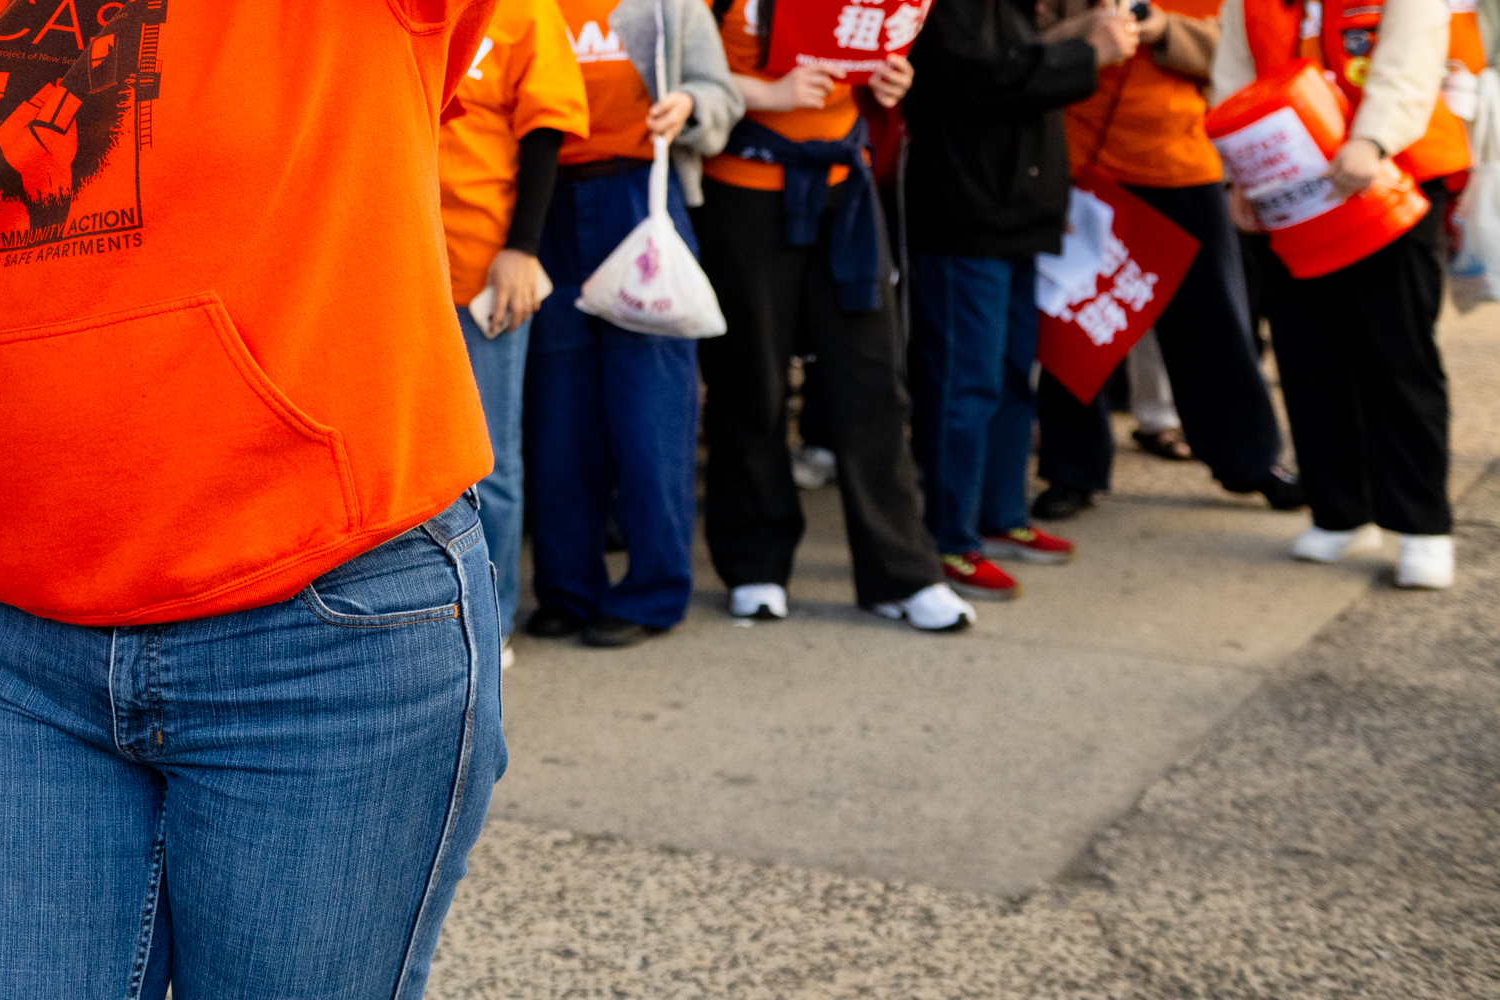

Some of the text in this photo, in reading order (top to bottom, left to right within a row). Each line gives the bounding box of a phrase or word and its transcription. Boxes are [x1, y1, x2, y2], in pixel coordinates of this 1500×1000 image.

[27, 52, 38, 60] of
[39, 53, 60, 63] New
[67, 207, 135, 235] ACTION
[3, 250, 34, 268] SAFE
[35, 232, 143, 263] APARTMENTS
